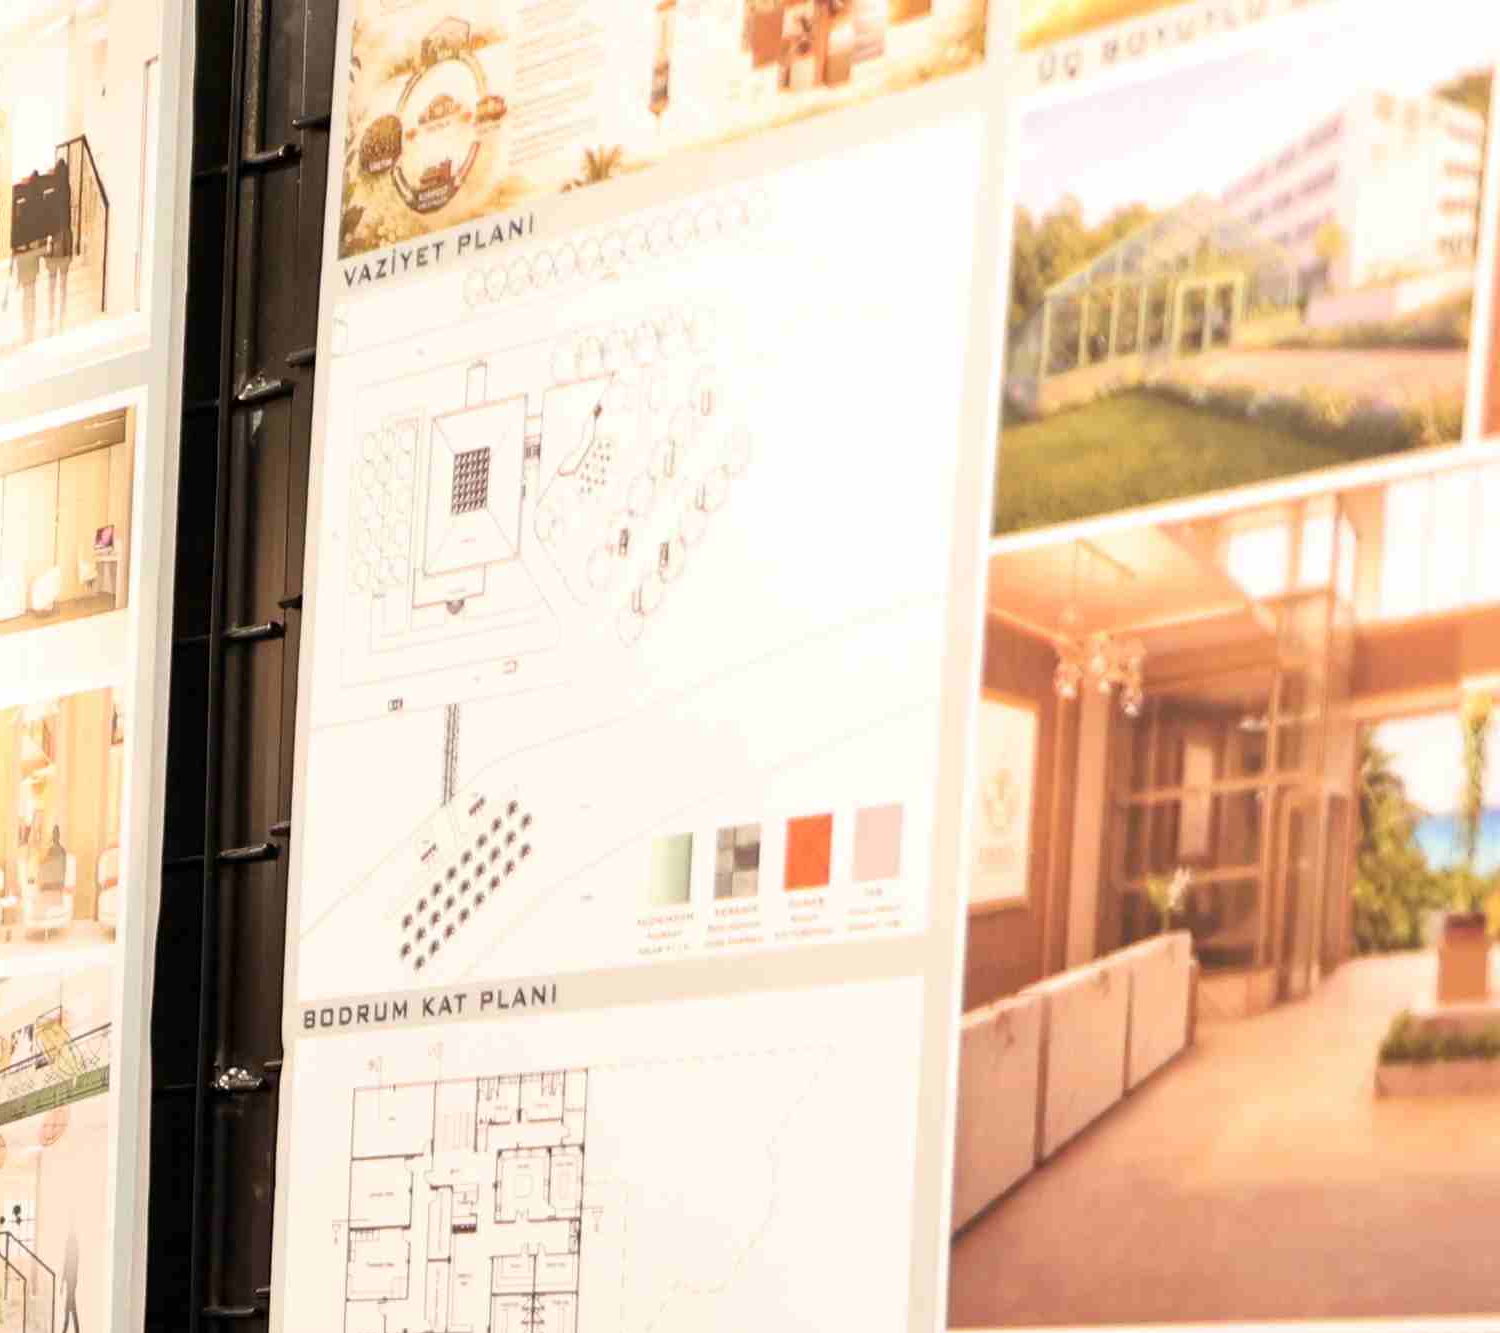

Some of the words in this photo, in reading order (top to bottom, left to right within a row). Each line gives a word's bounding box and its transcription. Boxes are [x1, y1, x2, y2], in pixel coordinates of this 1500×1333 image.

[342, 231, 446, 287] VAZİYET
[456, 212, 536, 261] PLANI
[303, 1001, 408, 1030] BODRUM
[422, 994, 466, 1018] KAT
[479, 983, 558, 1013] PLANI
